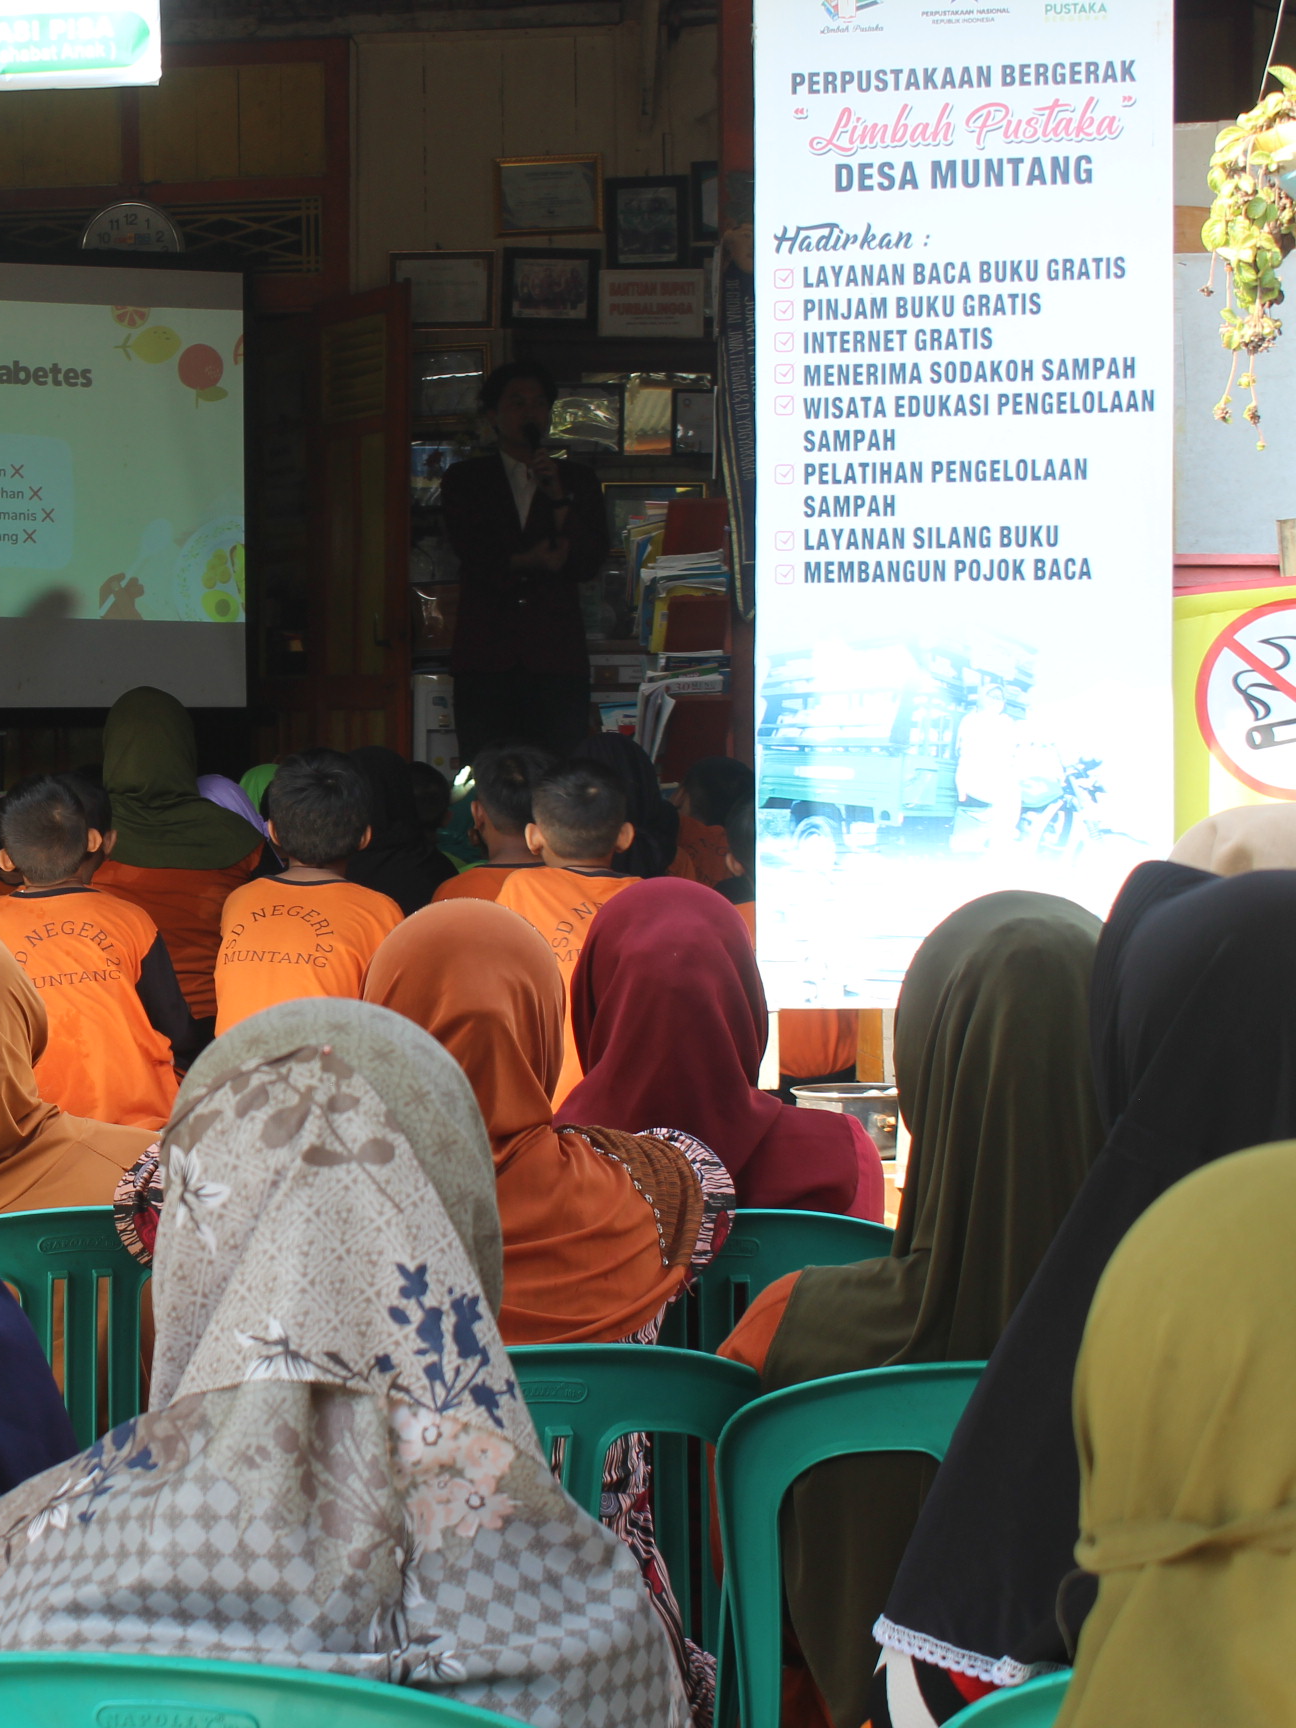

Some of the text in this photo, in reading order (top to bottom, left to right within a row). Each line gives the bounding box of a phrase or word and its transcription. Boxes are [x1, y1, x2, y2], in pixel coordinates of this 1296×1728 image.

[977, 7, 1010, 15] NASIONAL
[1044, 3, 1108, 15] PUSTAKA
[791, 59, 1136, 95] PERPUSTAKAAN BERGERAK
[835, 155, 1093, 193] DESA MUNTANG
[774, 222, 913, 254] Hadirkan
[803, 257, 1126, 289] LAYANAN BACA BUKU GRATIS
[803, 293, 1042, 321] PINJAM BUKU GRATIS
[803, 327, 993, 354] INTERNET GRATIS
[803, 357, 1136, 386] MENERIMA SODAKOH SAMPAH
[803, 390, 1155, 420] WISATA EDUKASI PENGELOLAAN
[803, 429, 896, 453] SAMPAH
[803, 458, 1088, 485] PELATIHAN PENGELOLAAN
[803, 495, 896, 518] SAMPAH
[803, 525, 1059, 551] LAYANAN SILANG BUKU
[803, 557, 1092, 584] MEMBANGUN POJOK BACA
[225, 904, 335, 953] SD NEGERI 2
[551, 921, 574, 948] SD
[25, 920, 120, 967] NEGERI 2
[224, 951, 329, 968] MUNTANG
[32, 969, 121, 989] UNTANG
